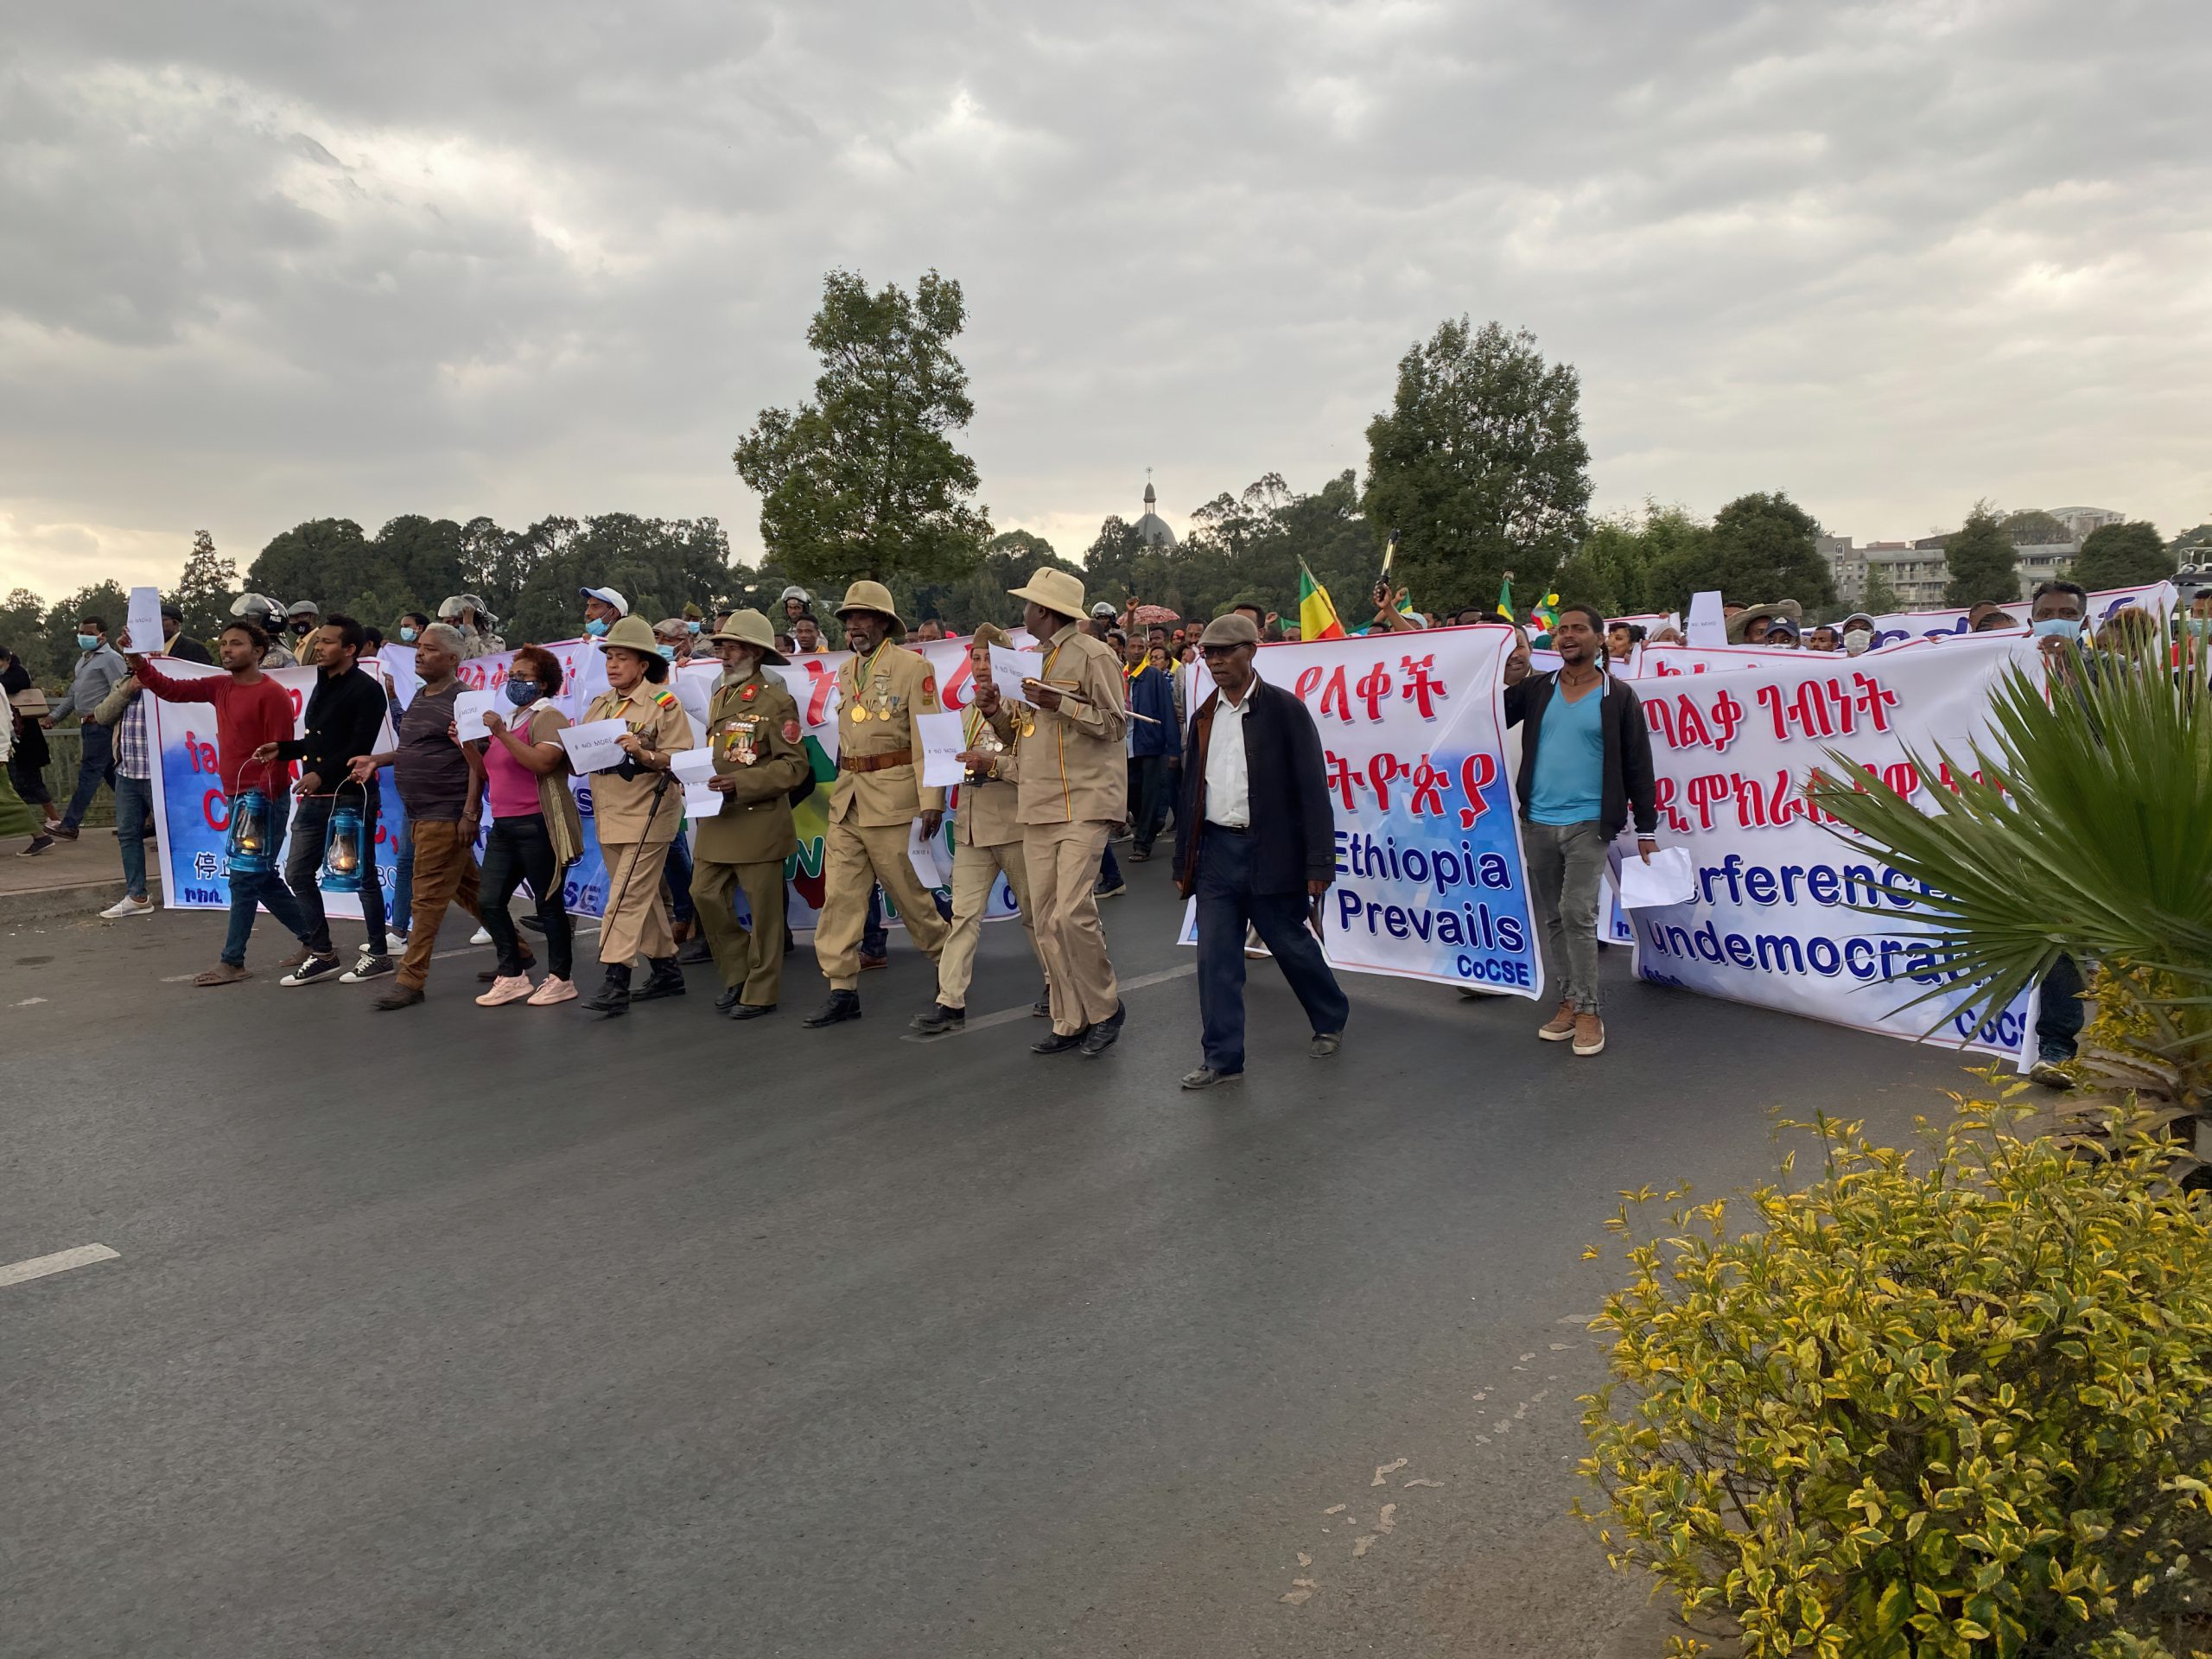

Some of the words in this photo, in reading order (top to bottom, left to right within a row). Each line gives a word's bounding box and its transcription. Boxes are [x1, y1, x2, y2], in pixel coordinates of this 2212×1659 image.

[1756, 671, 1897, 741] ገብነት
[1325, 750, 1497, 830] ትዮጵያ
[1334, 830, 1512, 896] Ethiopia
[1337, 888, 1526, 953] Prevails
[1457, 955, 1530, 987] CoCSE
